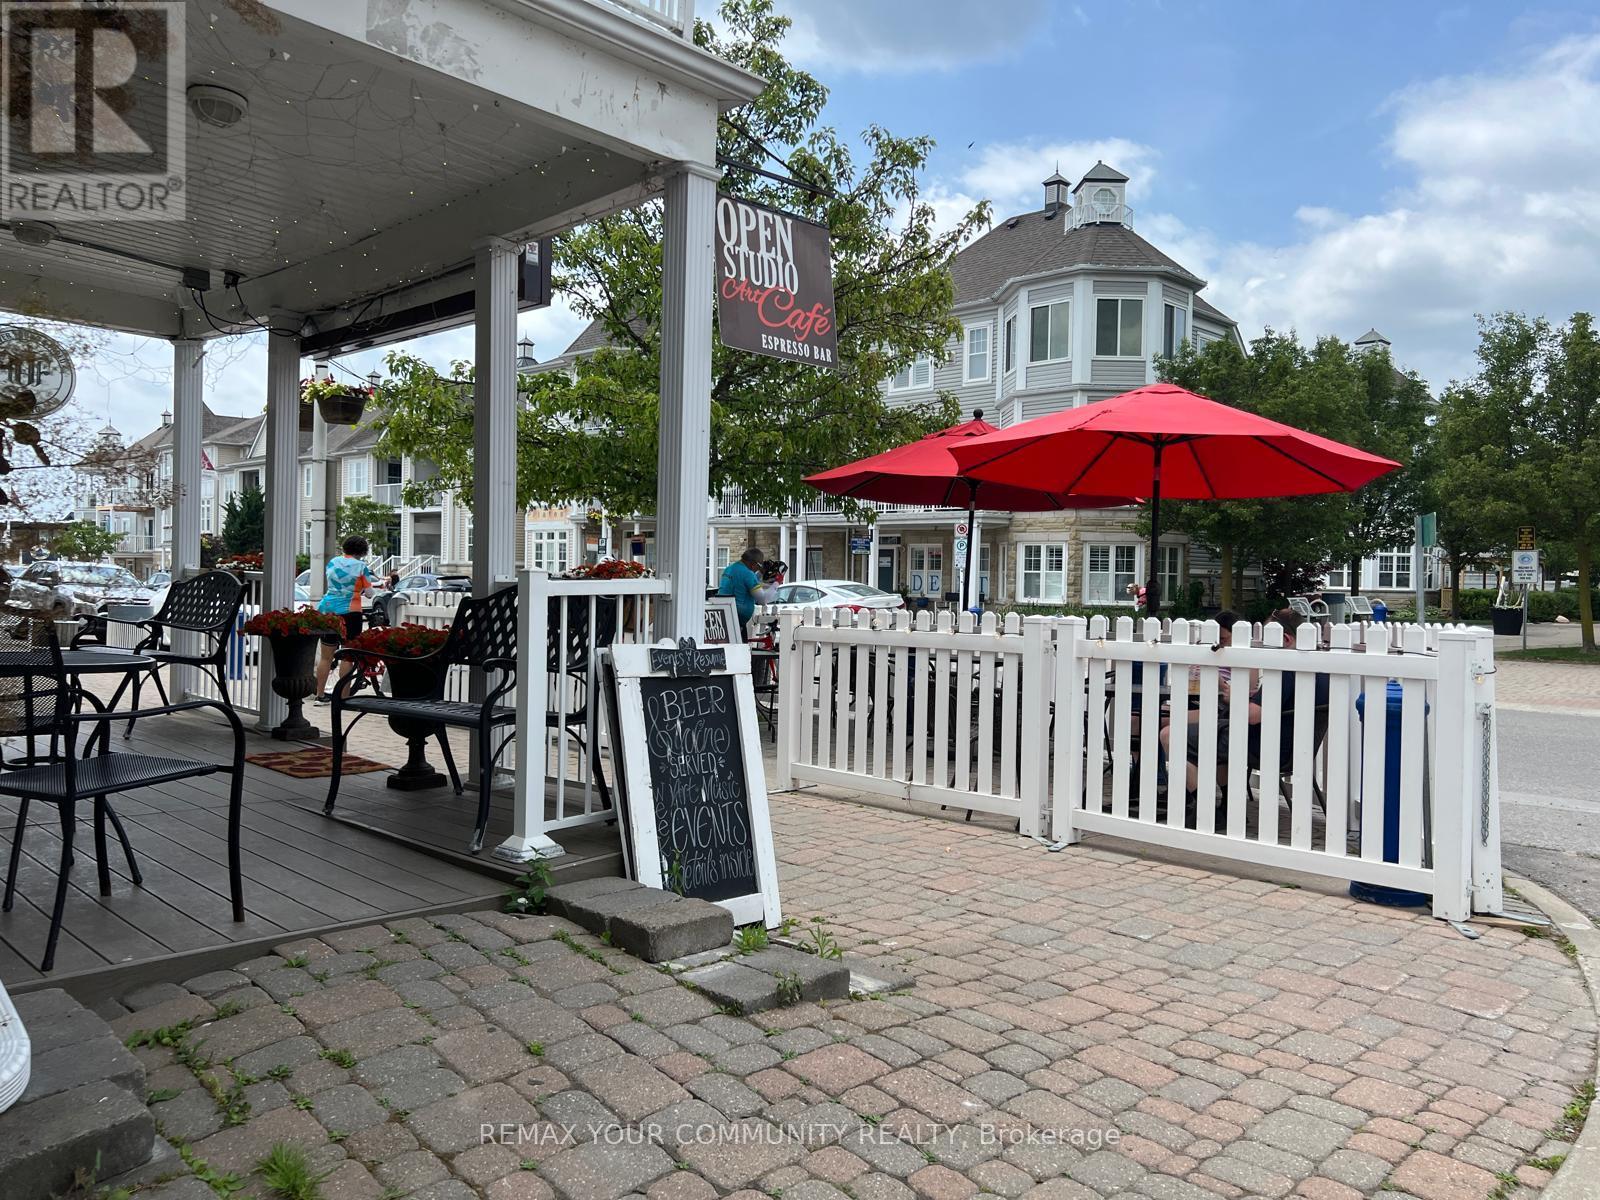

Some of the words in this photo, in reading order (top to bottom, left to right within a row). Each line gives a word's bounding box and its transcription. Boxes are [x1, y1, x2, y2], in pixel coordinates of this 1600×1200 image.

[717, 198, 794, 264] OPEN
[724, 244, 799, 295] STUDIO
[722, 277, 762, 304] Art
[757, 286, 831, 341] Café
[761, 333, 810, 358] ESPRESSO
[813, 345, 832, 363] BAR
[651, 649, 684, 671] Events
[660, 685, 726, 721] BEER
[669, 752, 717, 778] SERVED
[701, 774, 741, 805] Music
[671, 801, 748, 853] EVENTS
